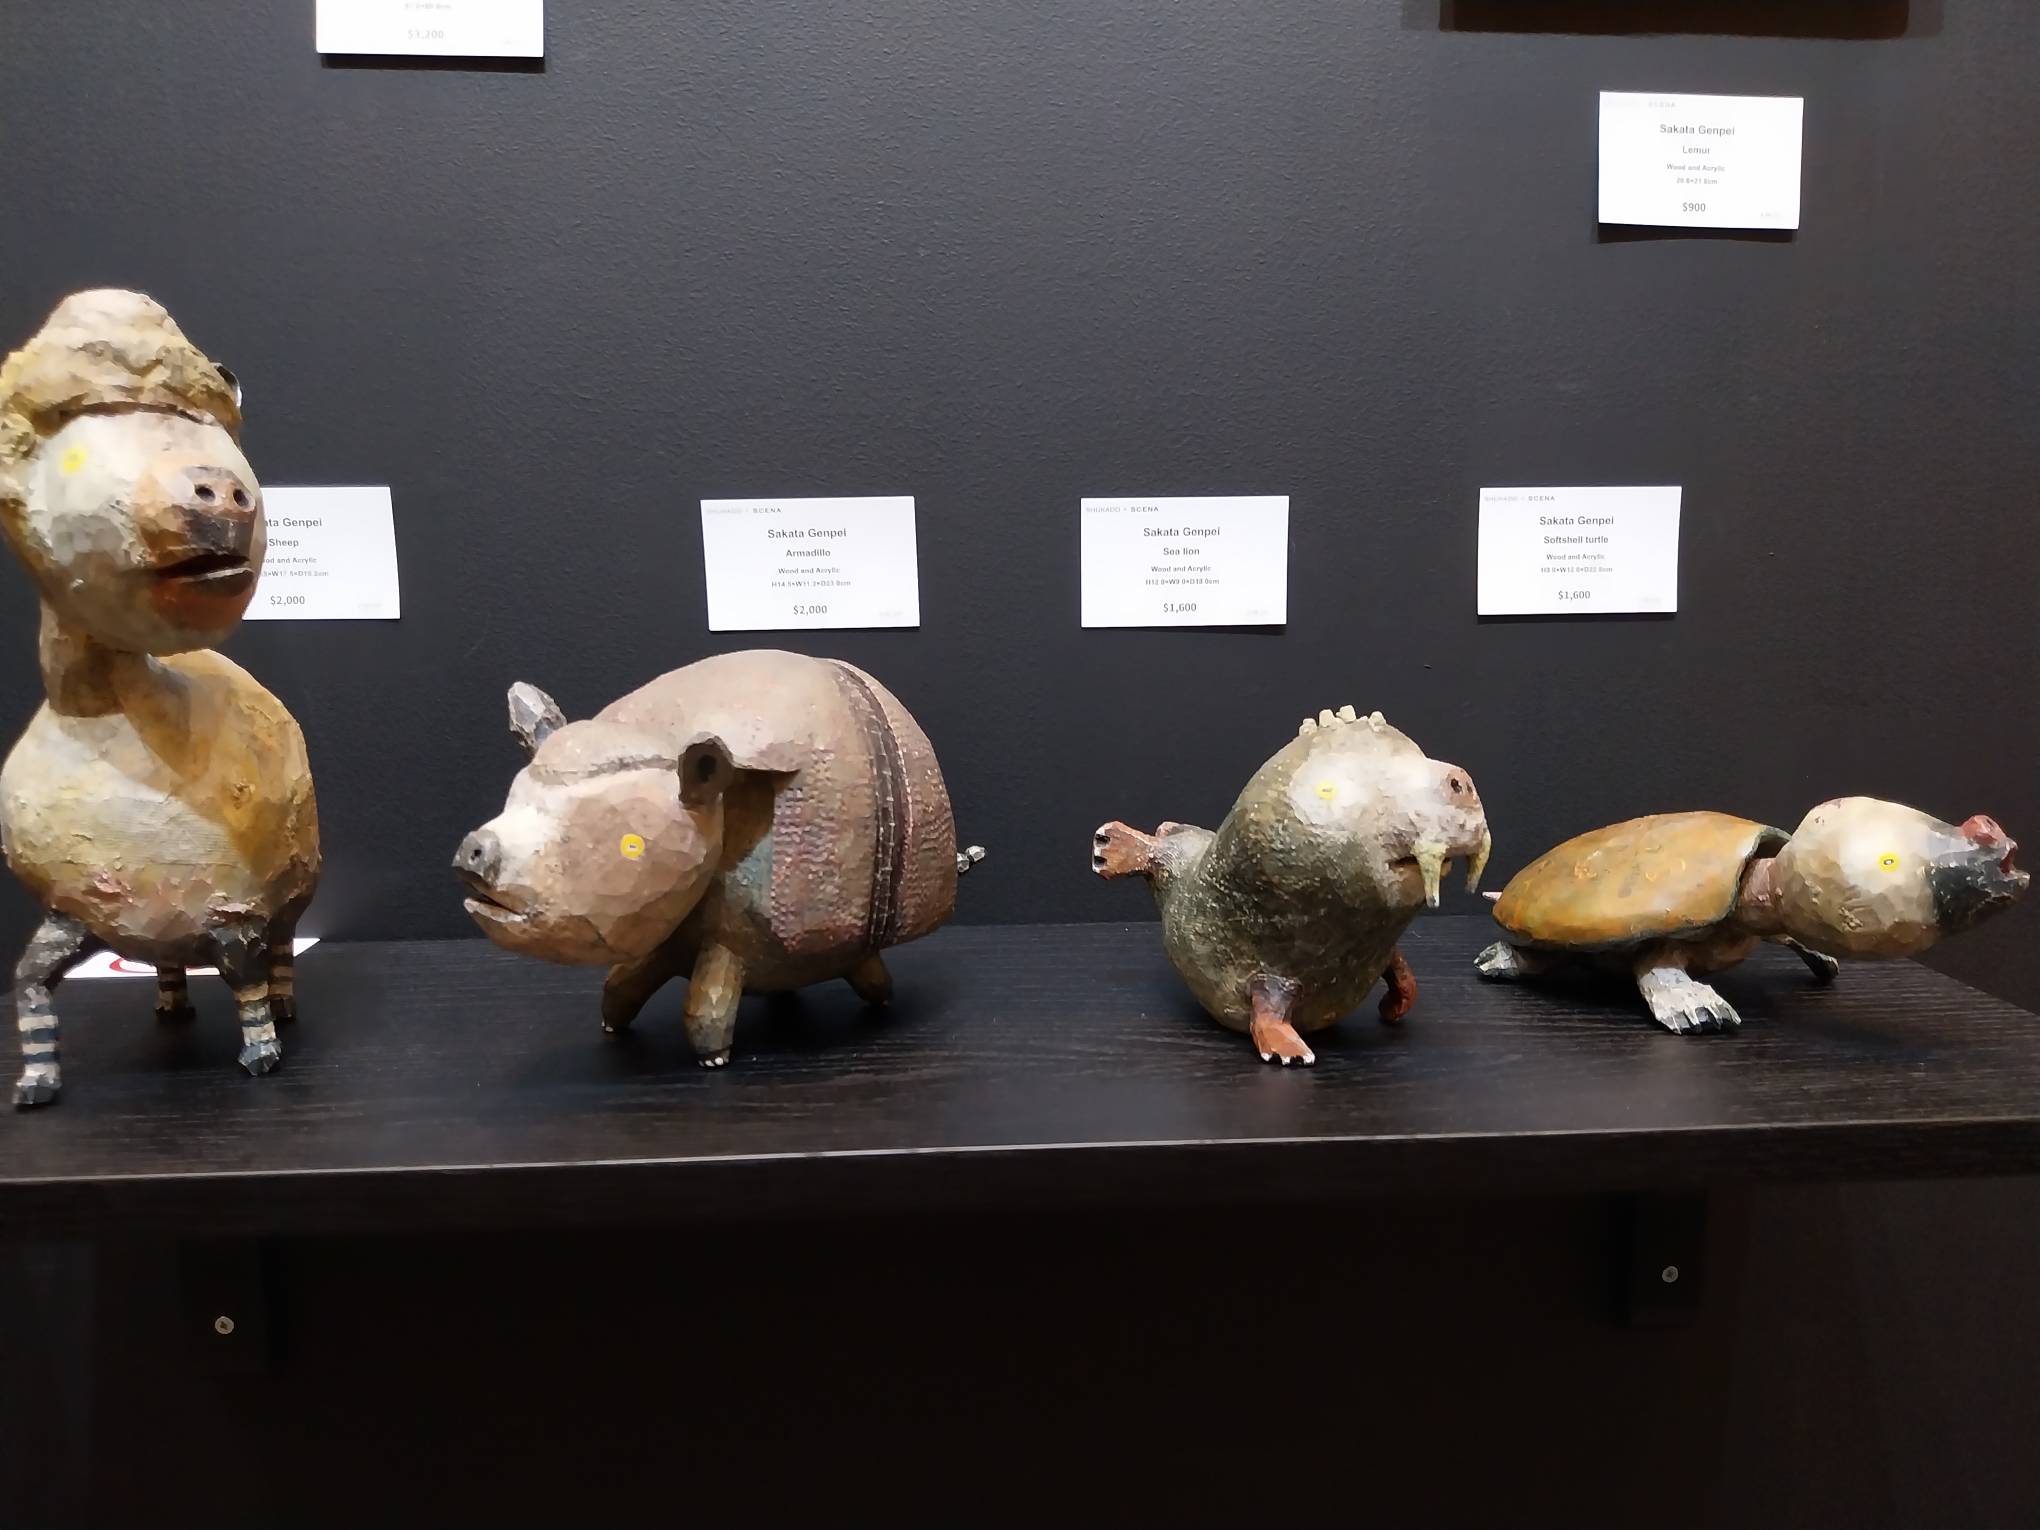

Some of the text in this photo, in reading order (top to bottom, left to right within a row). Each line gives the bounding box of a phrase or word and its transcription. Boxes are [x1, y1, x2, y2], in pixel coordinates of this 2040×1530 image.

[1659, 123, 1735, 137] Sakata Genpei
[1682, 202, 1706, 213] $900
[282, 517, 323, 529] Genpei
[1539, 515, 1614, 527] Sakata Genpei
[767, 528, 847, 540] Sakata Genpei
[1143, 526, 1220, 538] Sakata Genpei
[268, 538, 300, 548] Sheep
[1543, 535, 1609, 545] Softshell turtle
[785, 548, 831, 558] Armadillo
[1162, 547, 1200, 556] Sea lion
[1546, 553, 1566, 561] Wood
[1568, 553, 1581, 561] and
[778, 567, 799, 575] Wood
[1151, 565, 1212, 574] Wood and Acrylic
[270, 595, 306, 606] $2,000
[1557, 590, 1591, 601] $1,600
[793, 605, 828, 616] $2,000
[1163, 602, 1197, 614] $1,600
